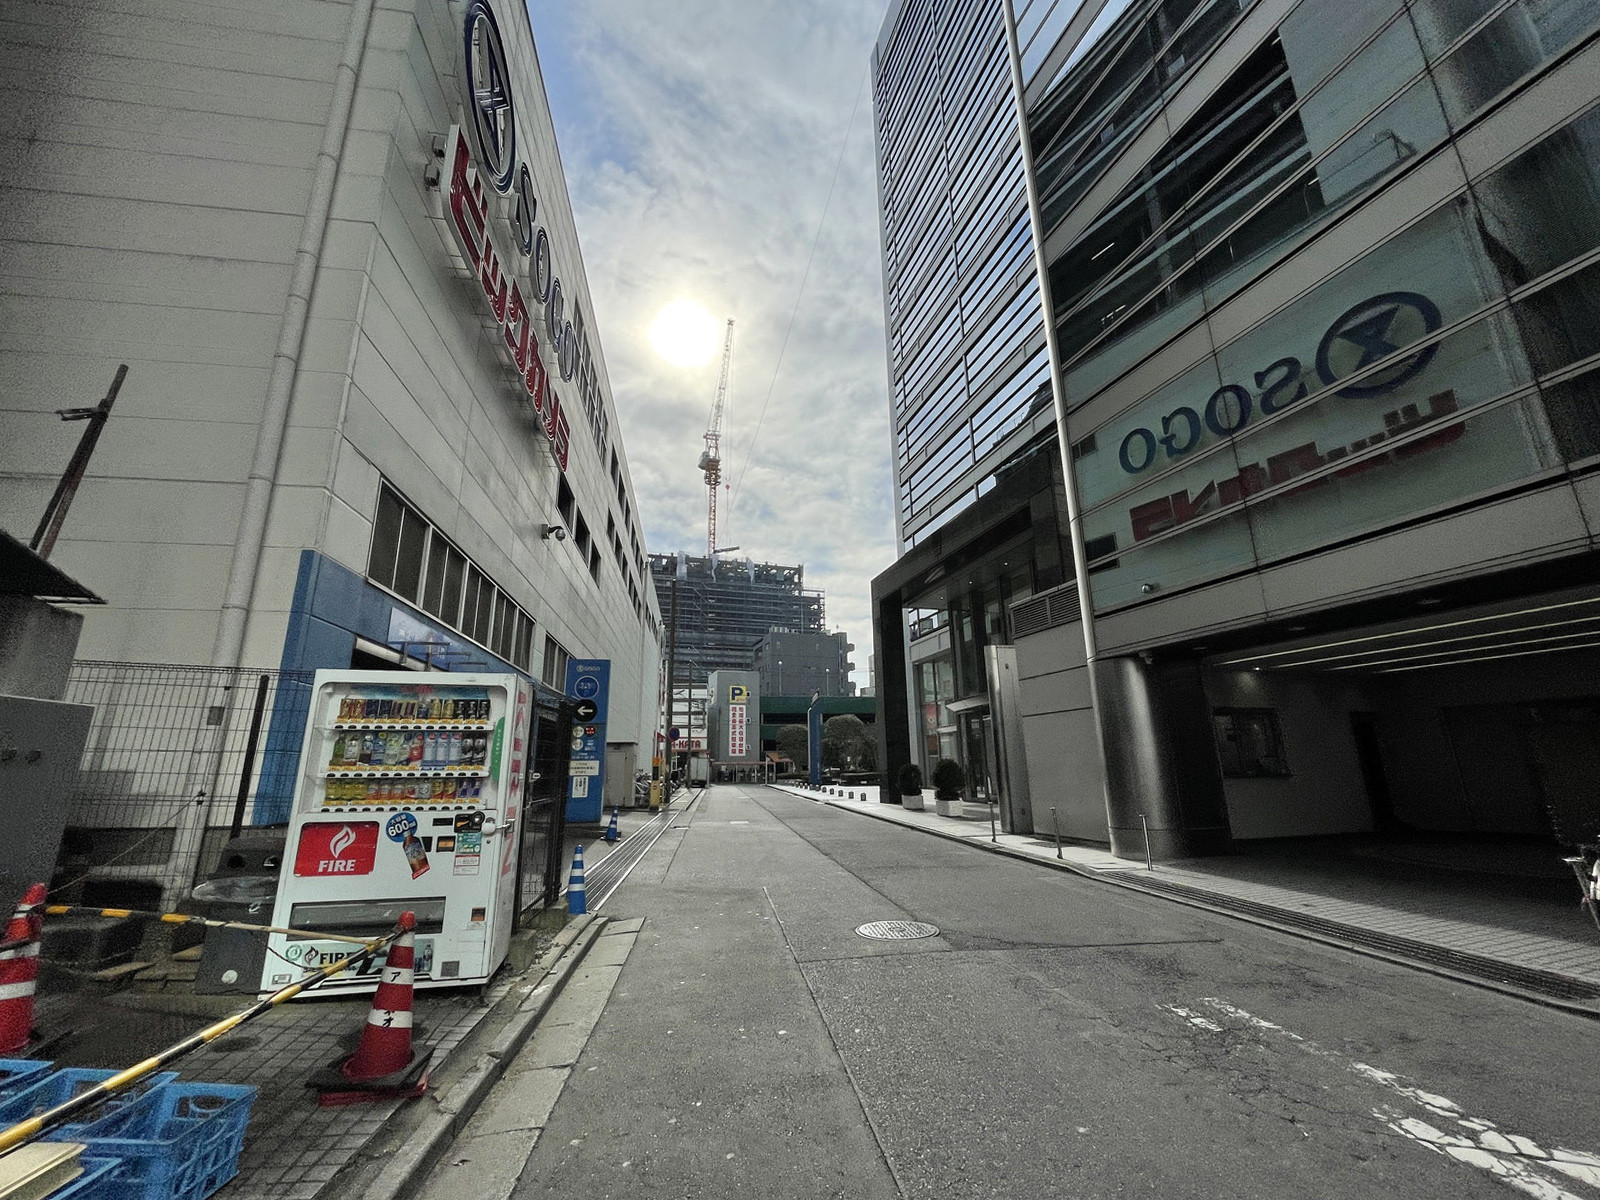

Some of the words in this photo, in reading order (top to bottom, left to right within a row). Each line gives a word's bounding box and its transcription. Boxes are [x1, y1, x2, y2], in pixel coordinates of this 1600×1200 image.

[511, 161, 575, 383] SOGO
[731, 687, 743, 701] P
[318, 859, 356, 873] FIRE
